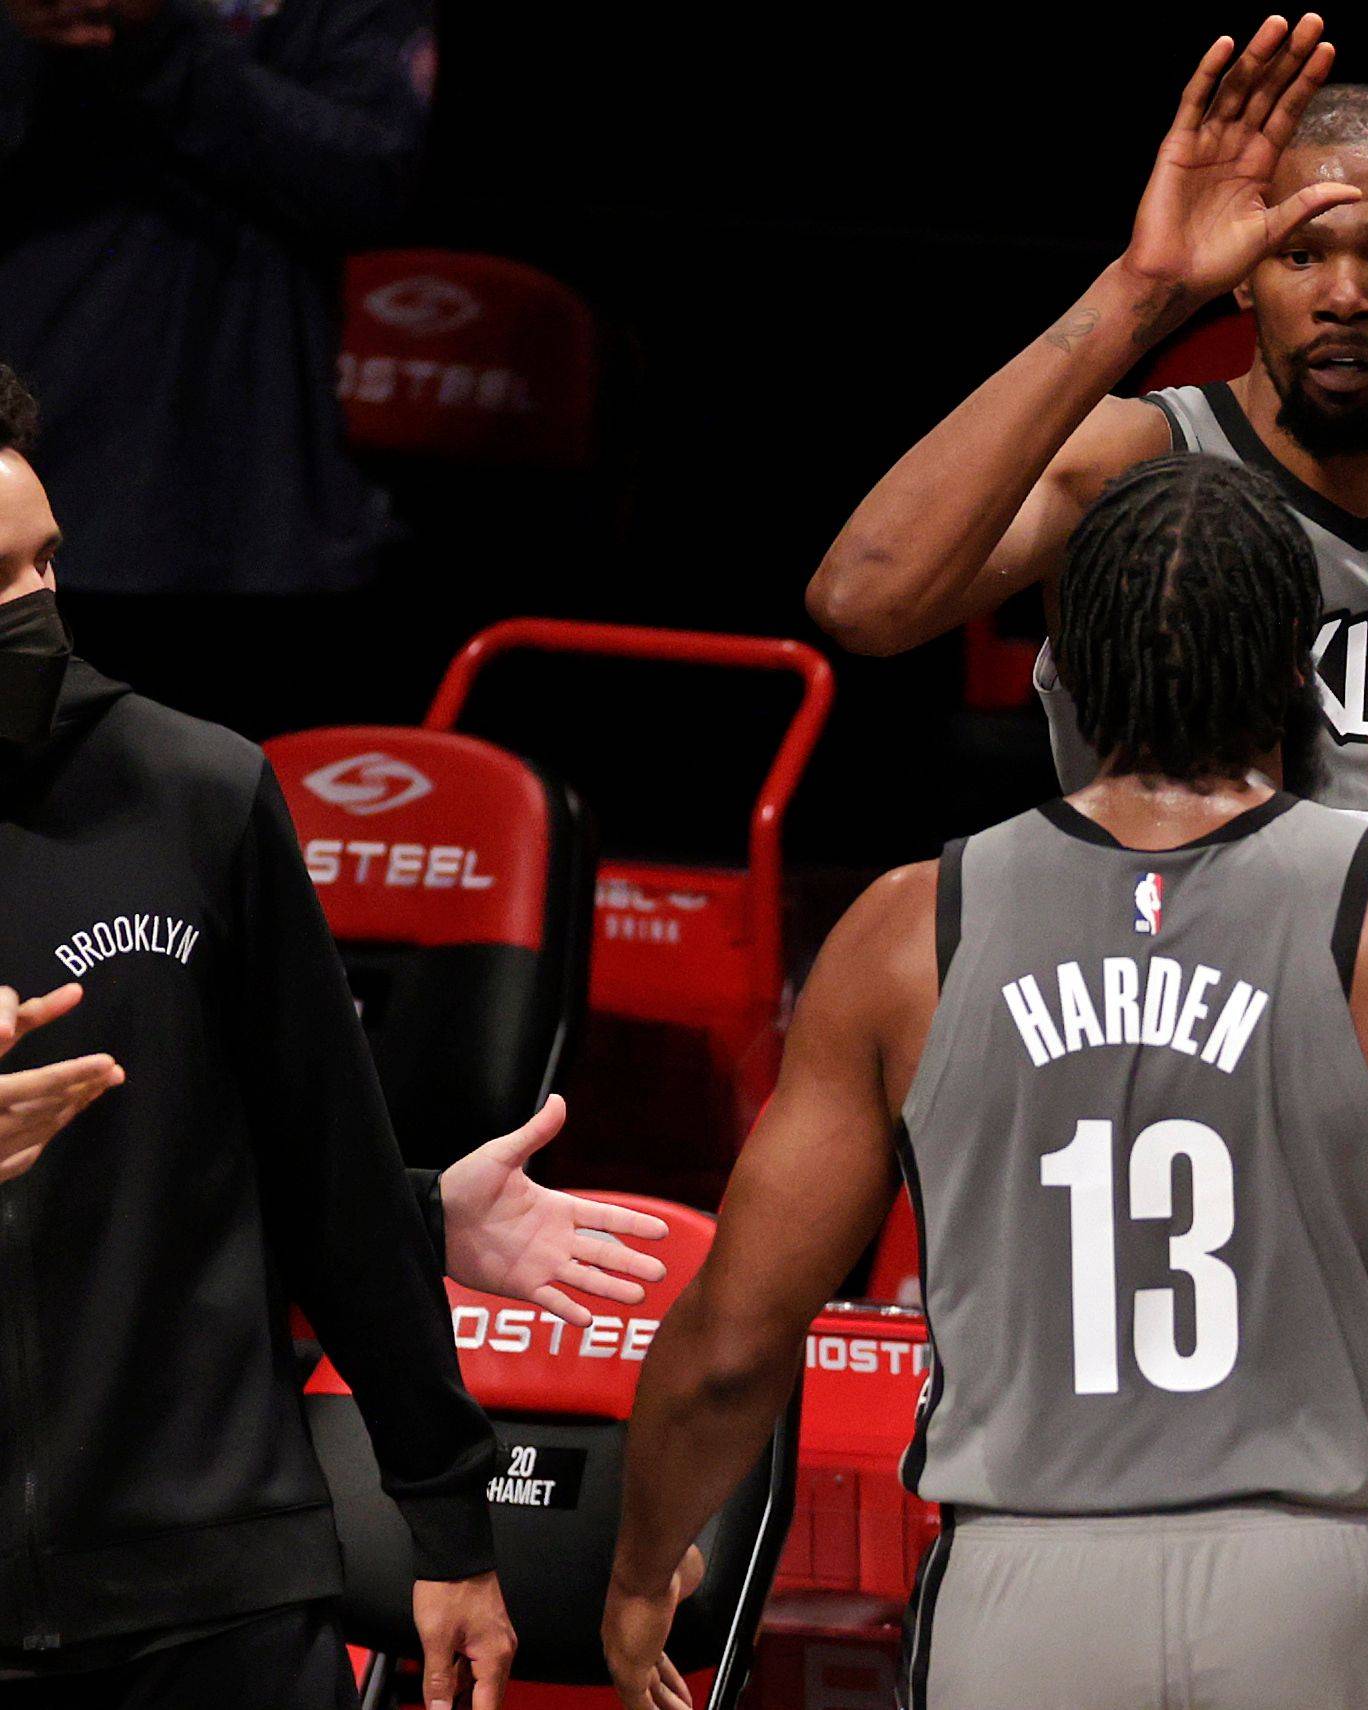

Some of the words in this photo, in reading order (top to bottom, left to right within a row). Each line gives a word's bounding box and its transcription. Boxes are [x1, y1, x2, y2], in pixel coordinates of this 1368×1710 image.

[305, 839, 494, 890] STEEL
[54, 913, 200, 977] BROOKLYN
[1002, 956, 1269, 1074] HARDEN
[1040, 1118, 1239, 1395] 13
[507, 1445, 537, 1478] 20
